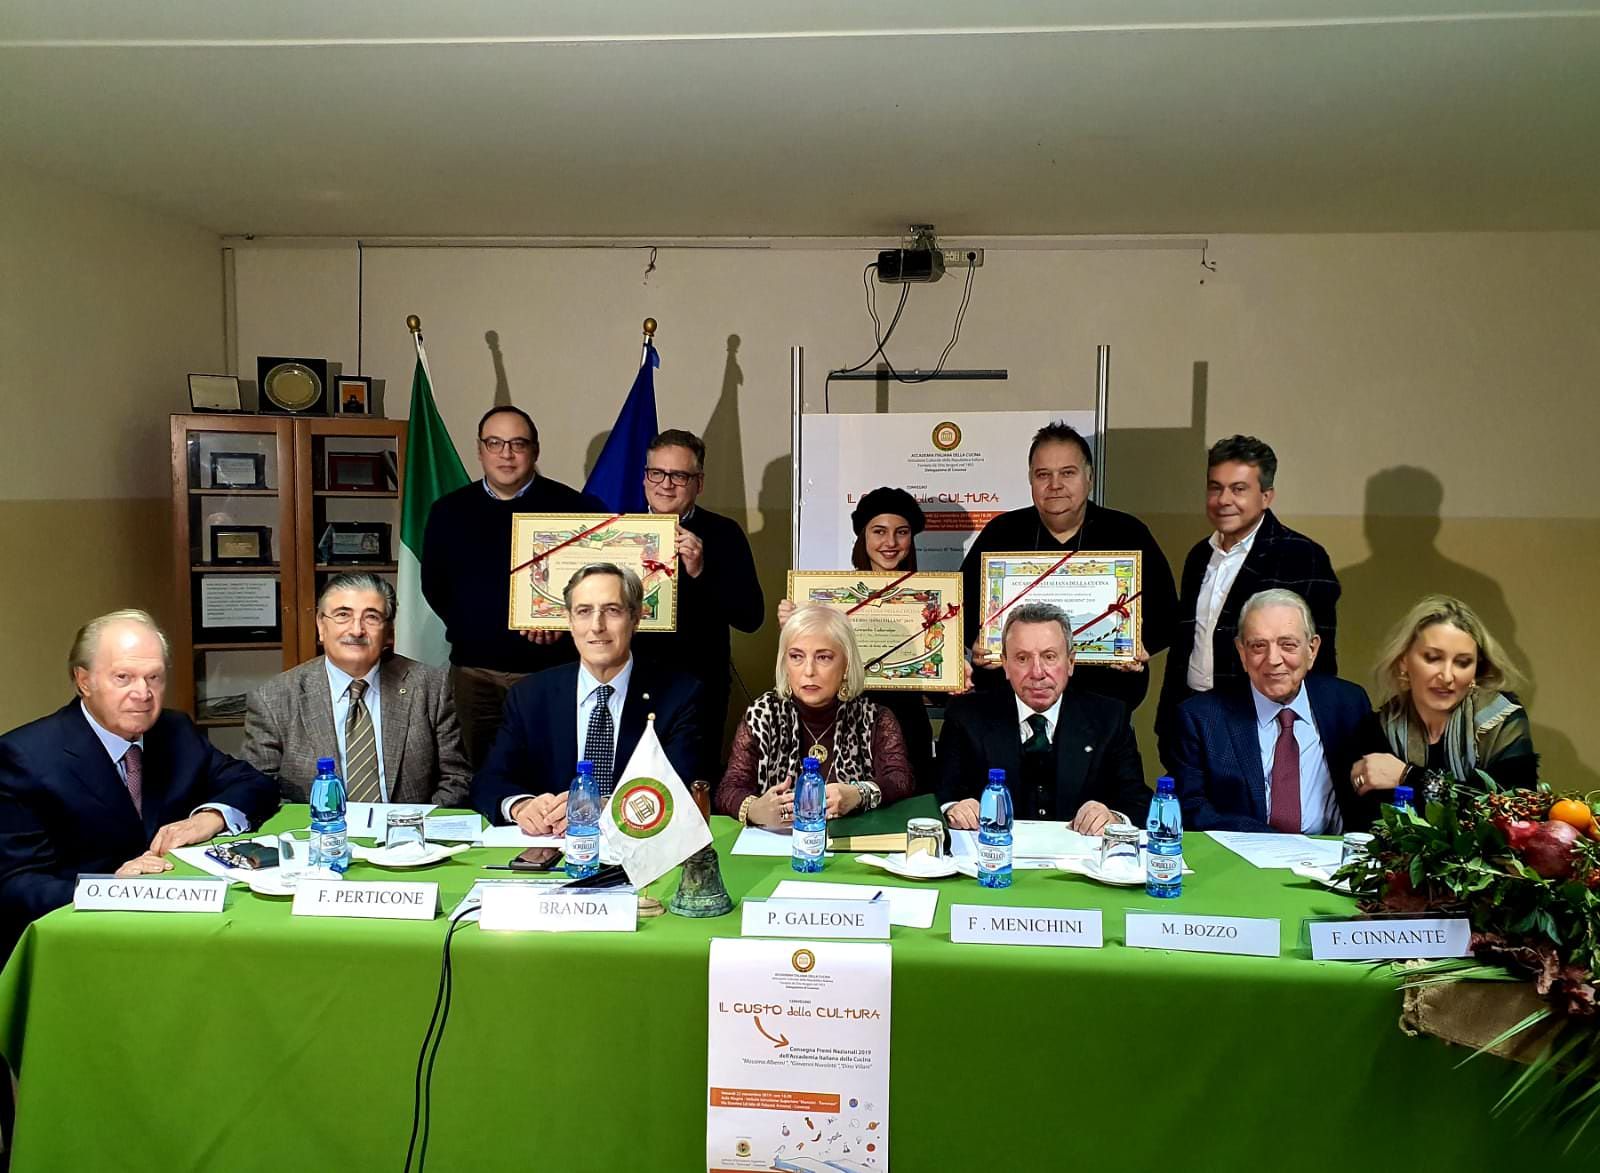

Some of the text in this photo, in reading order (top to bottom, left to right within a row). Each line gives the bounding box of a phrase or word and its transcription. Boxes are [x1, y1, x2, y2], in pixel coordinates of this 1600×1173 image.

[938, 492, 1000, 503] CULTURA
[87, 884, 217, 902] O. CAVALCANTI
[318, 889, 424, 905] F. PERTICONE
[540, 902, 608, 915] BRANDA
[768, 911, 865, 927] P. GALEONE
[991, 917, 1083, 934] MENICHINI
[1162, 922, 1238, 938] M. BOZZO
[1332, 930, 1447, 945] F. CINNANTE
[719, 1002, 729, 1013] IL
[734, 1002, 782, 1015] GUSTO
[816, 1007, 881, 1020] CULTURA
